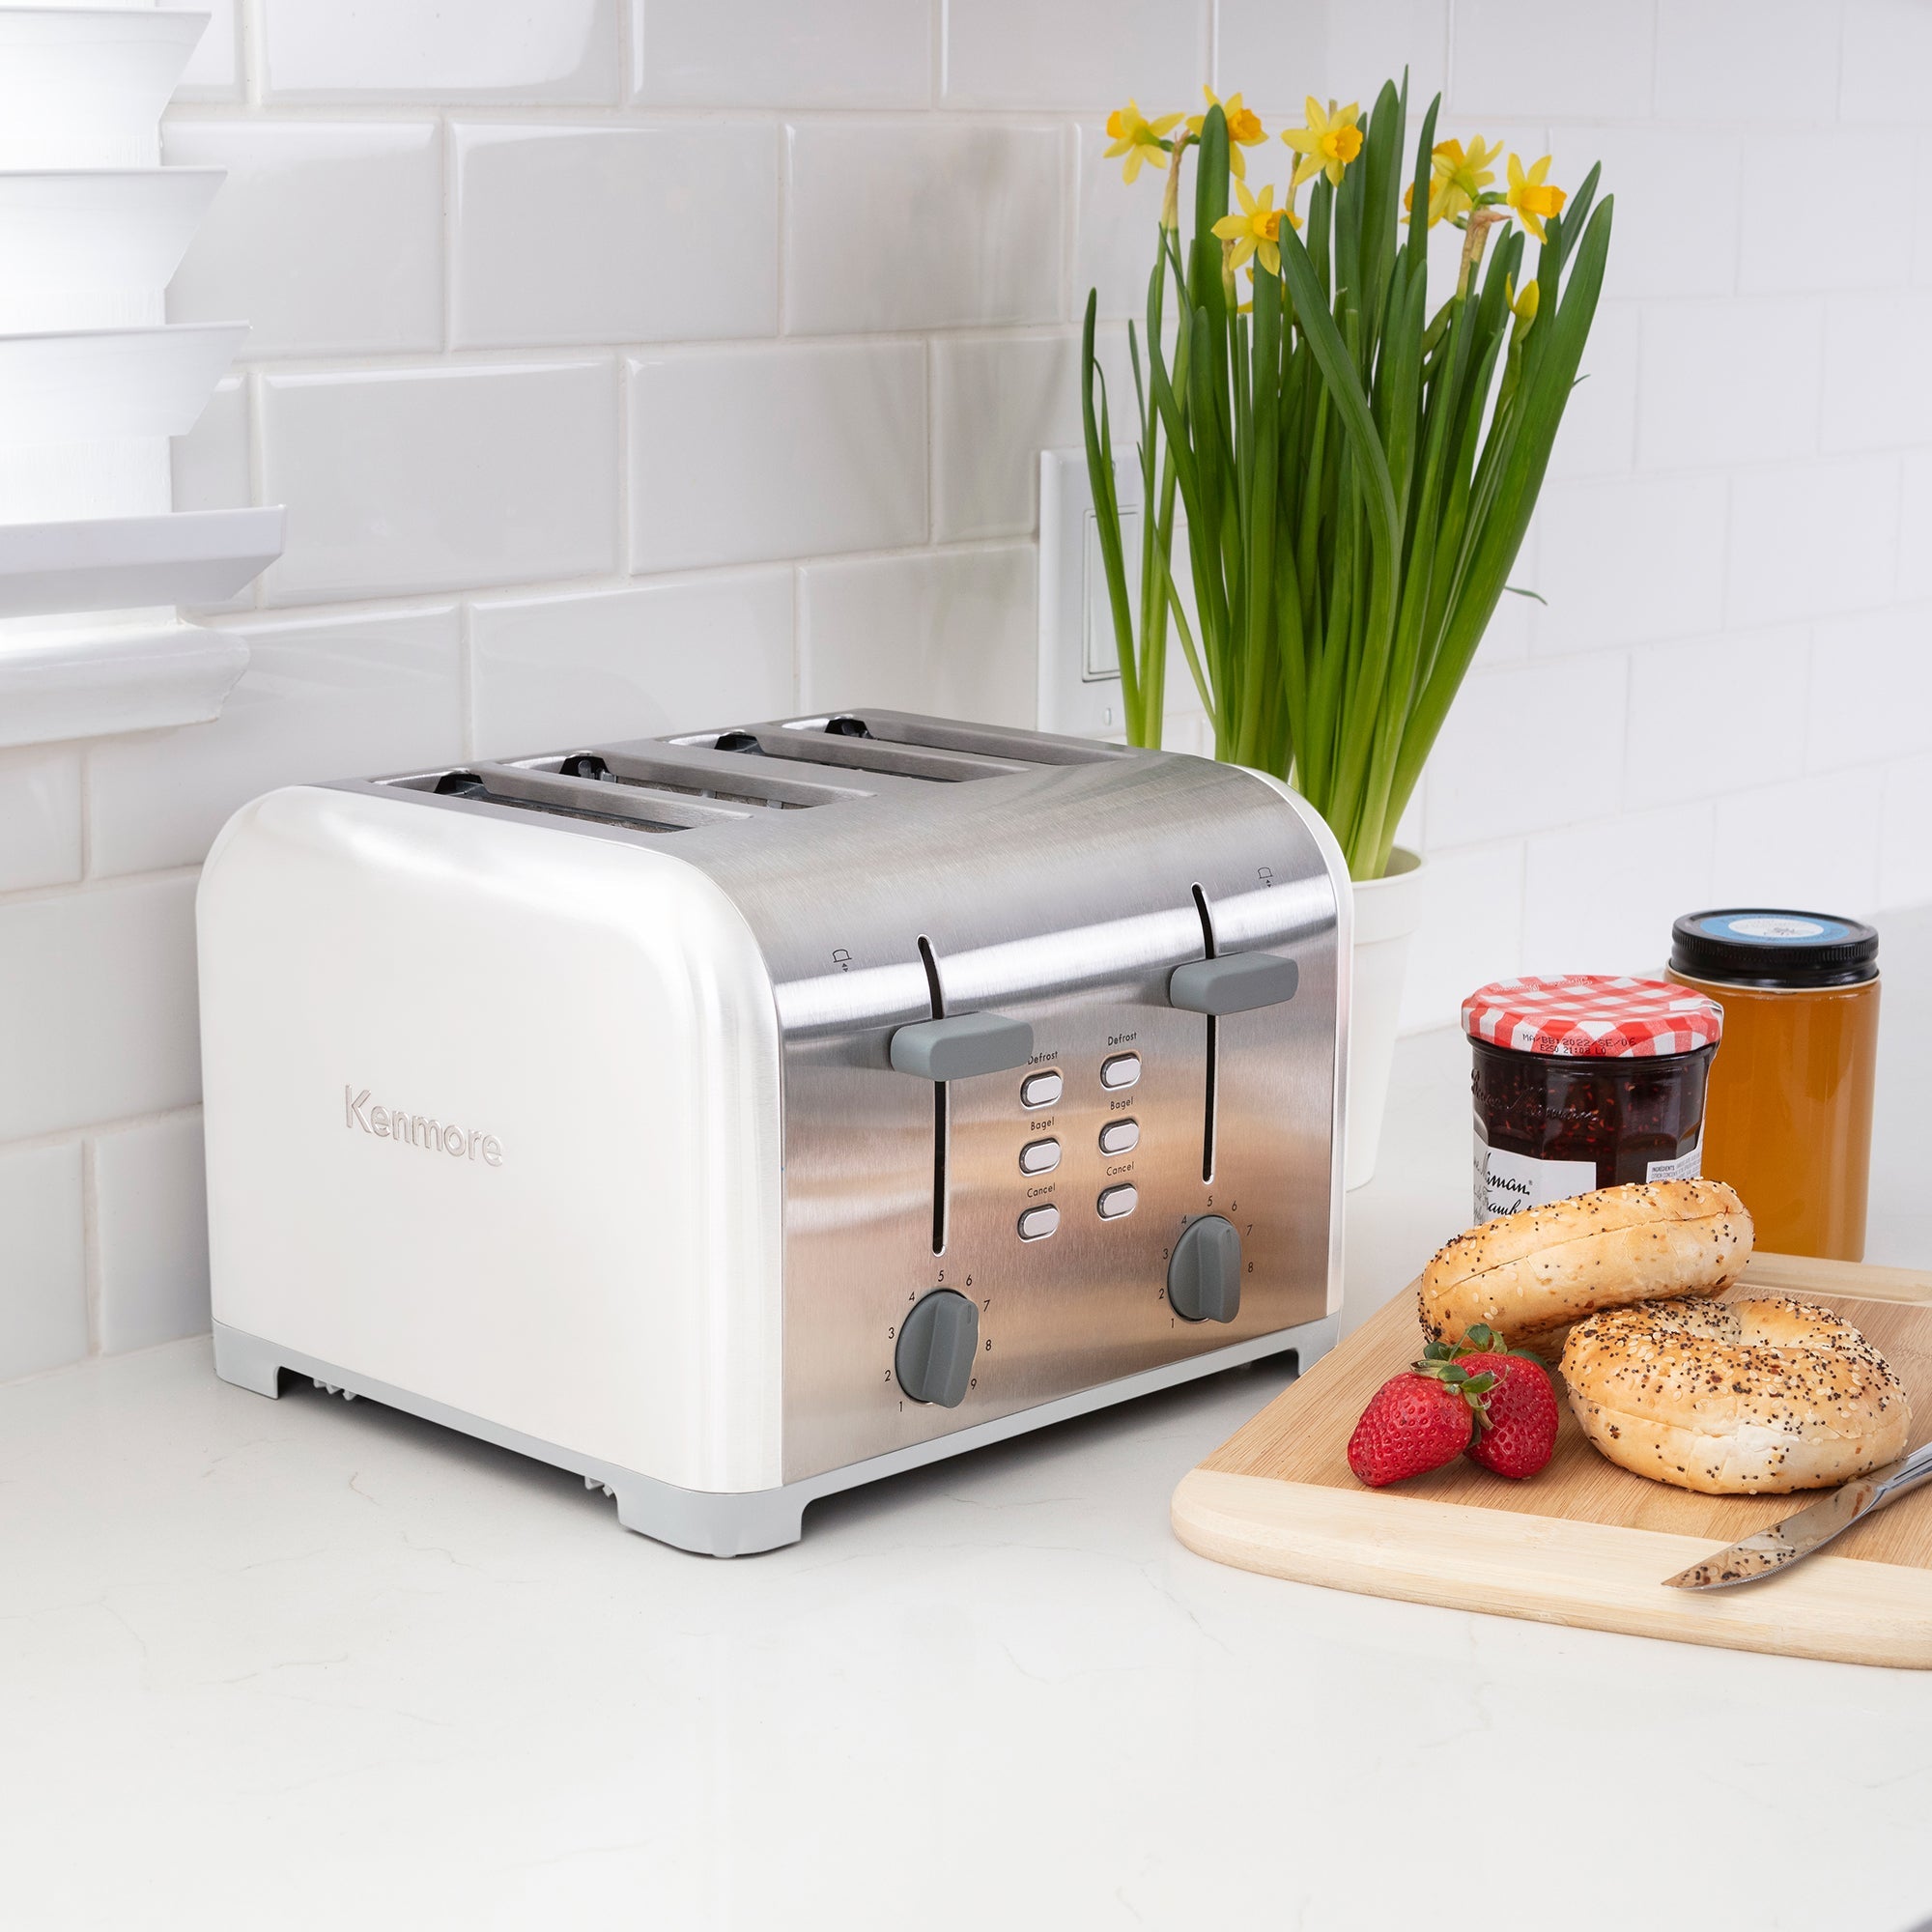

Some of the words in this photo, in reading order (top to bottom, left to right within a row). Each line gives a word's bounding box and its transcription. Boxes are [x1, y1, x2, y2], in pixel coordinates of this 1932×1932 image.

[1107, 1032, 1137, 1046] Defrost
[1110, 1096, 1133, 1111] Bagel
[345, 1084, 503, 1167] Kenmore
[1030, 1117, 1055, 1131] Bagel
[1106, 1161, 1134, 1177] Cancel
[1027, 1182, 1056, 1198] Cancel
[1208, 1196, 1213, 1207] 5
[1232, 1201, 1237, 1211] 6
[1181, 1215, 1187, 1225] 4
[1246, 1225, 1253, 1236] 7
[1163, 1248, 1169, 1260] 3
[1248, 1262, 1254, 1273] 8
[937, 1269, 945, 1282] 5
[966, 1274, 973, 1287] 6
[908, 1292, 916, 1302] 4
[1158, 1289, 1165, 1300] 2
[983, 1299, 991, 1313] 7
[1171, 1318, 1175, 1329] 1
[888, 1326, 895, 1339] 3
[985, 1339, 992, 1351] 8
[884, 1370, 892, 1382] 2
[970, 1378, 978, 1390] 9
[898, 1401, 903, 1412] 1
